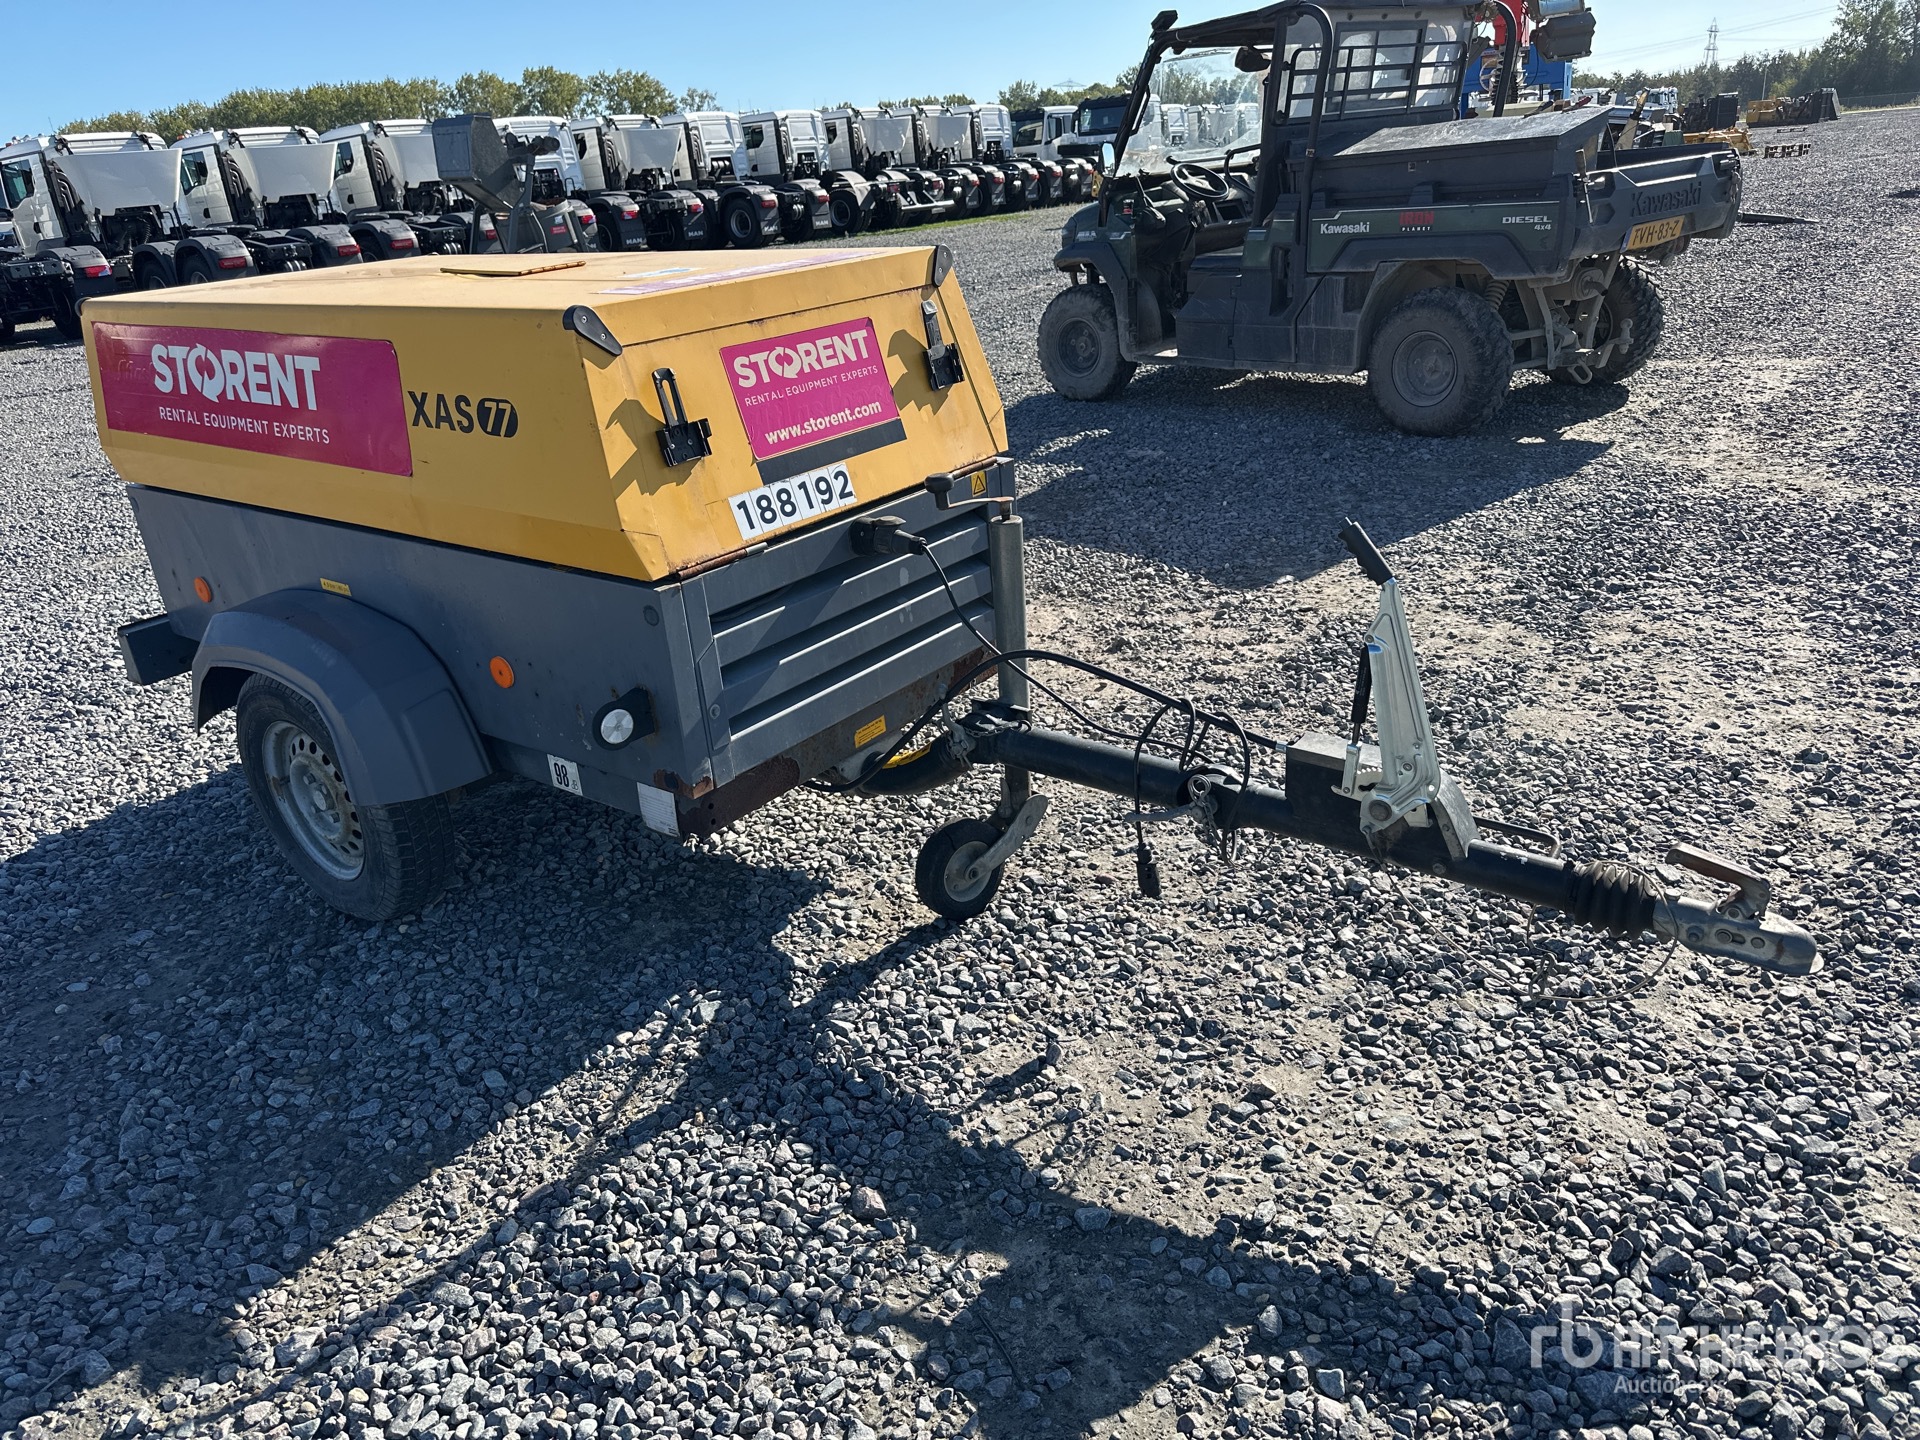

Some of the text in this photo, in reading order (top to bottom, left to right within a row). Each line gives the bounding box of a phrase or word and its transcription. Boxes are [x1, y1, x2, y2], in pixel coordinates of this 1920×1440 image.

[1399, 210, 1434, 225] IRON
[1631, 181, 1702, 217] Kawasaki
[1320, 222, 1370, 234] Kawasaki
[1502, 215, 1553, 224] DIESEL
[626, 237, 643, 245] MAN
[151, 342, 321, 411] STORENT
[734, 329, 868, 388] STORENT
[745, 365, 879, 407] RENTAL EQUIPMENT EXPERTS
[159, 406, 330, 444] RENTAL EQUIPMENT EXPERTS
[407, 390, 512, 438] XAS 77
[765, 400, 883, 445] www.storent.com
[736, 470, 854, 531] 188192
[553, 762, 570, 787] 98
